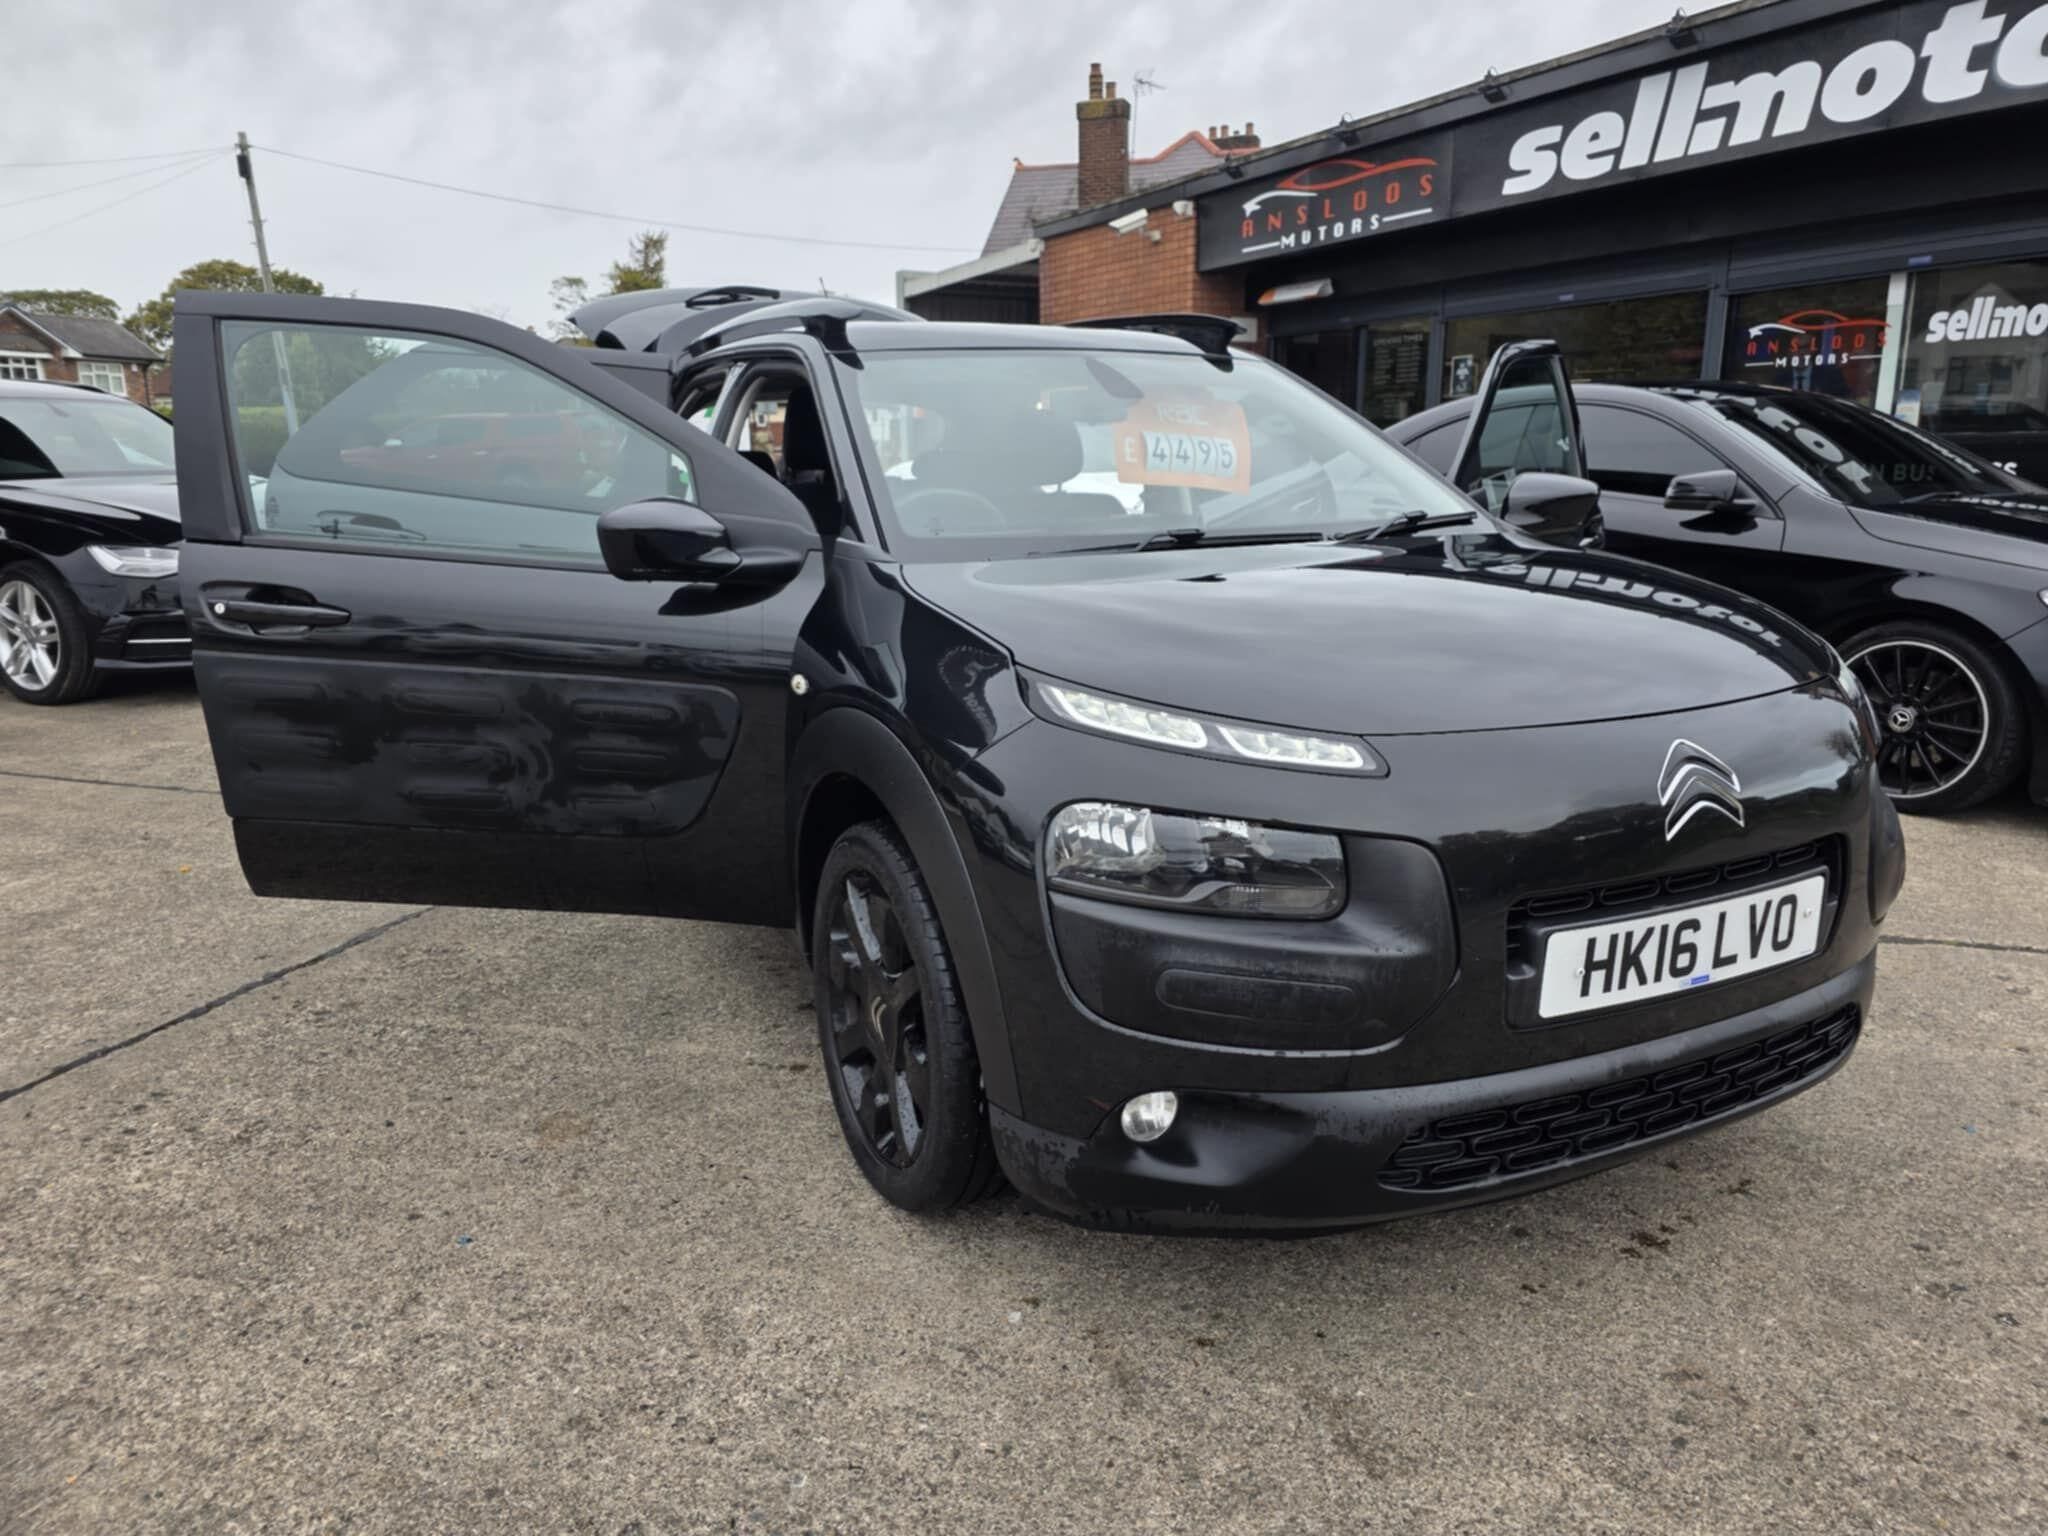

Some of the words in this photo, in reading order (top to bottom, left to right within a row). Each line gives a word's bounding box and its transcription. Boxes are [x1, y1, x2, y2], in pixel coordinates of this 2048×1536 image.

[1241, 173, 1433, 238] ANSLOOS
[1746, 331, 1886, 356] ANSLOOS
[1775, 352, 1849, 368] MOTORS
[1152, 436, 1233, 470] 4495
[1580, 918, 1701, 998] HK16
[1712, 894, 1797, 969] LVO
